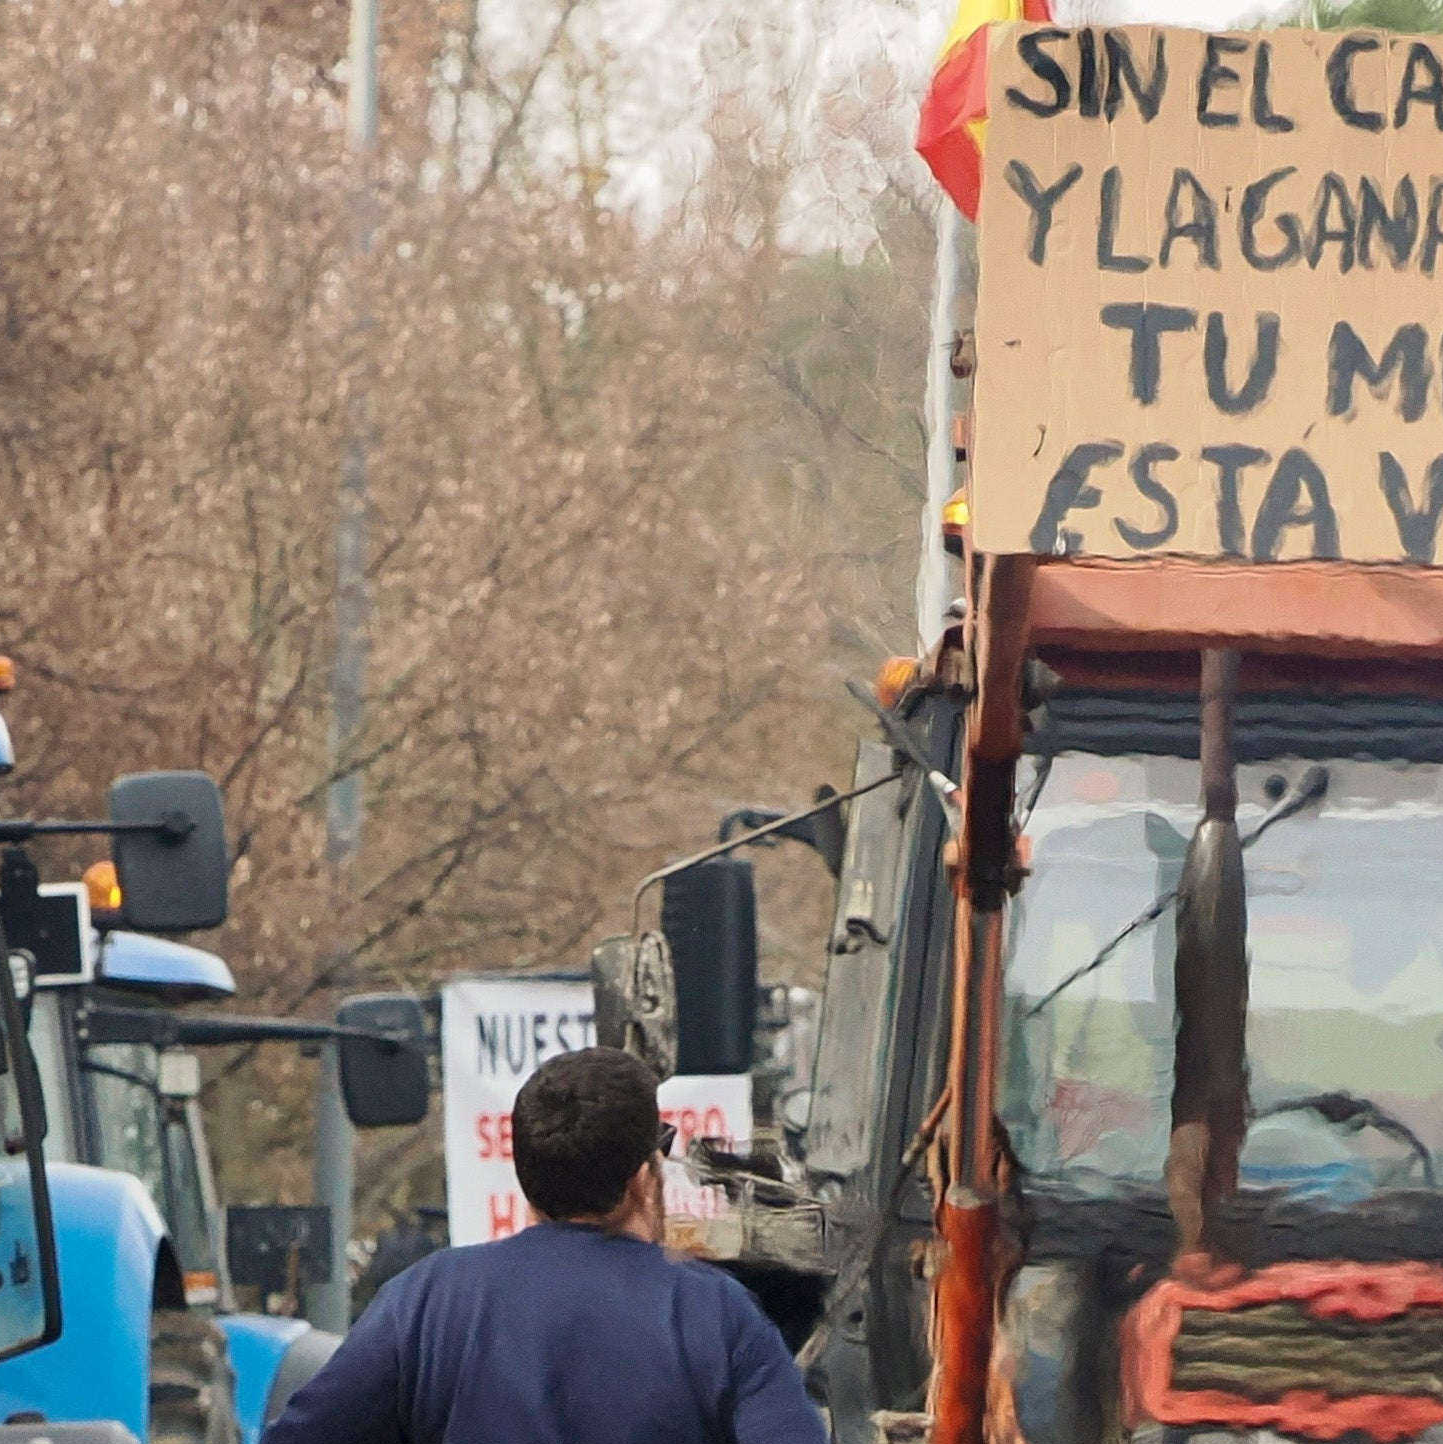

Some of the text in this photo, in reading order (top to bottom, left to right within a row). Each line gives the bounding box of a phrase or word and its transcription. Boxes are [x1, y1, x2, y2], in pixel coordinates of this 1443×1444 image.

[1005, 27, 1168, 124] SIN
[1196, 36, 1294, 133] EL
[1004, 160, 1083, 267] Y
[1097, 166, 1219, 274] LA
[1101, 302, 1280, 415] TU
